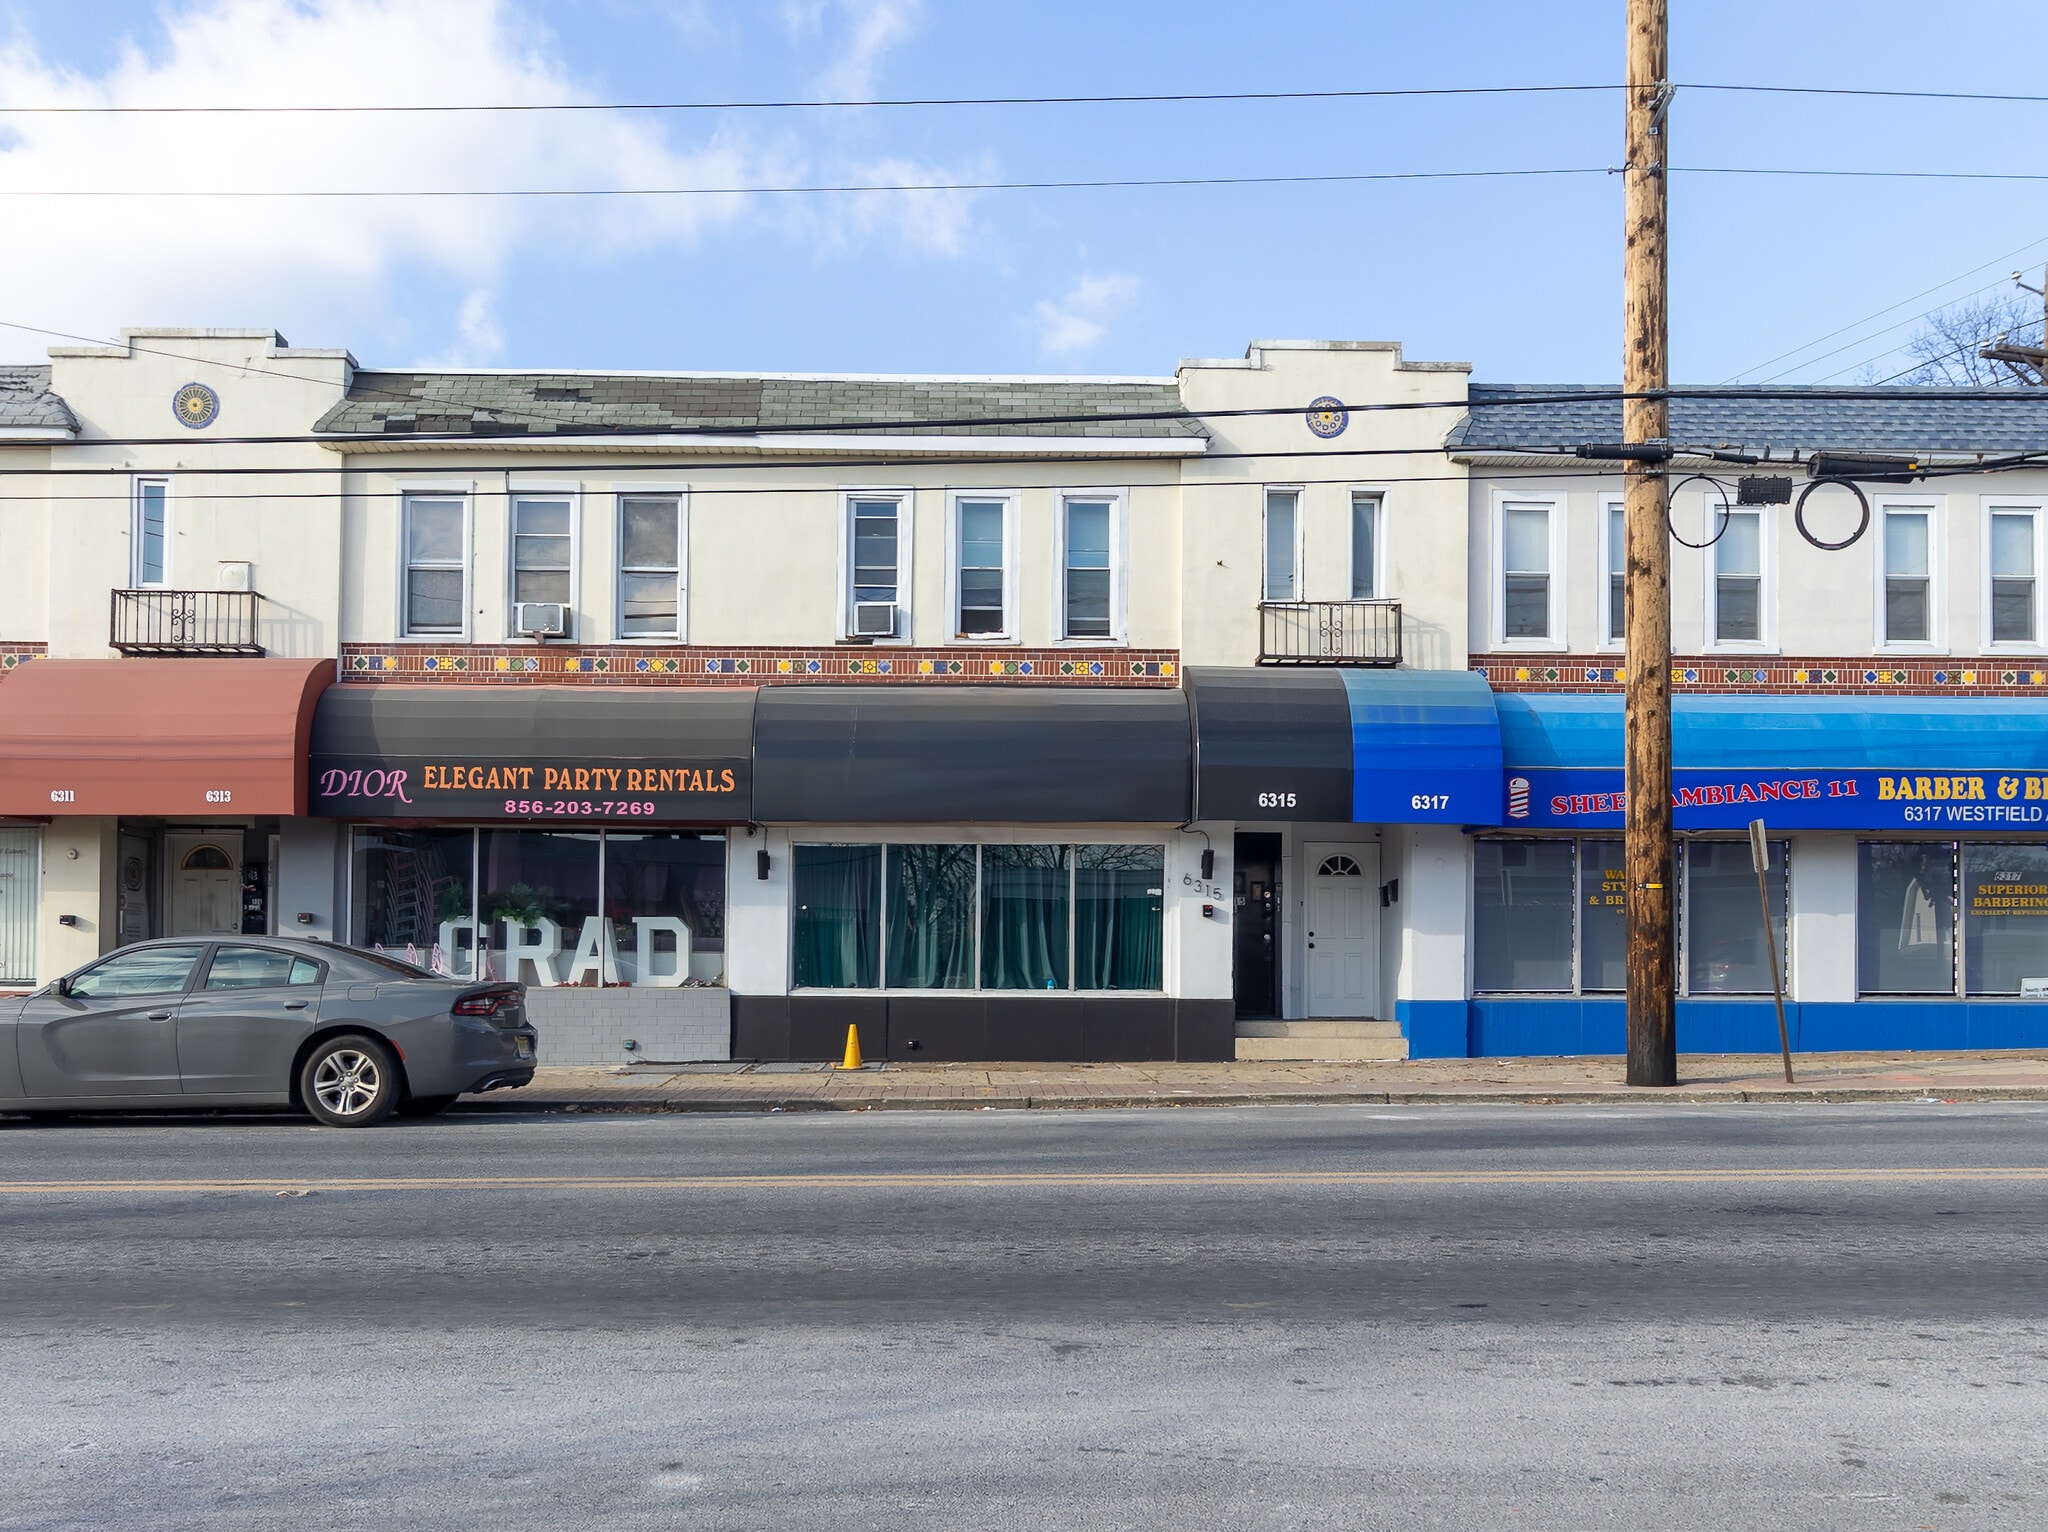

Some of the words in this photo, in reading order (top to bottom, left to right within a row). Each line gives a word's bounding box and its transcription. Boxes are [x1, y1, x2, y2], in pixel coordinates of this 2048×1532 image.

[320, 769, 413, 804] DIOR
[423, 765, 534, 790] ELEGANT
[543, 767, 622, 791] PARTY
[626, 769, 735, 793] RENTALS
[1877, 776, 1986, 800] BARBER
[1997, 775, 2020, 800] &
[50, 789, 75, 803] 6311
[205, 789, 232, 803] 6313
[1258, 792, 1297, 808] 6315
[1411, 795, 1449, 810] 6317
[1551, 792, 1626, 814] SHEE
[504, 799, 655, 815] 856-203-7269
[1903, 806, 1942, 822] 6317
[1946, 806, 2043, 822] WESTFIELD
[1604, 868, 1626, 880] WA
[1182, 872, 1224, 901] 6315
[1601, 881, 1626, 892] STY
[1978, 884, 2048, 895] SUPERIOR
[1589, 895, 1600, 906] &
[1605, 895, 1626, 906] BR
[438, 914, 694, 988] GRAD
